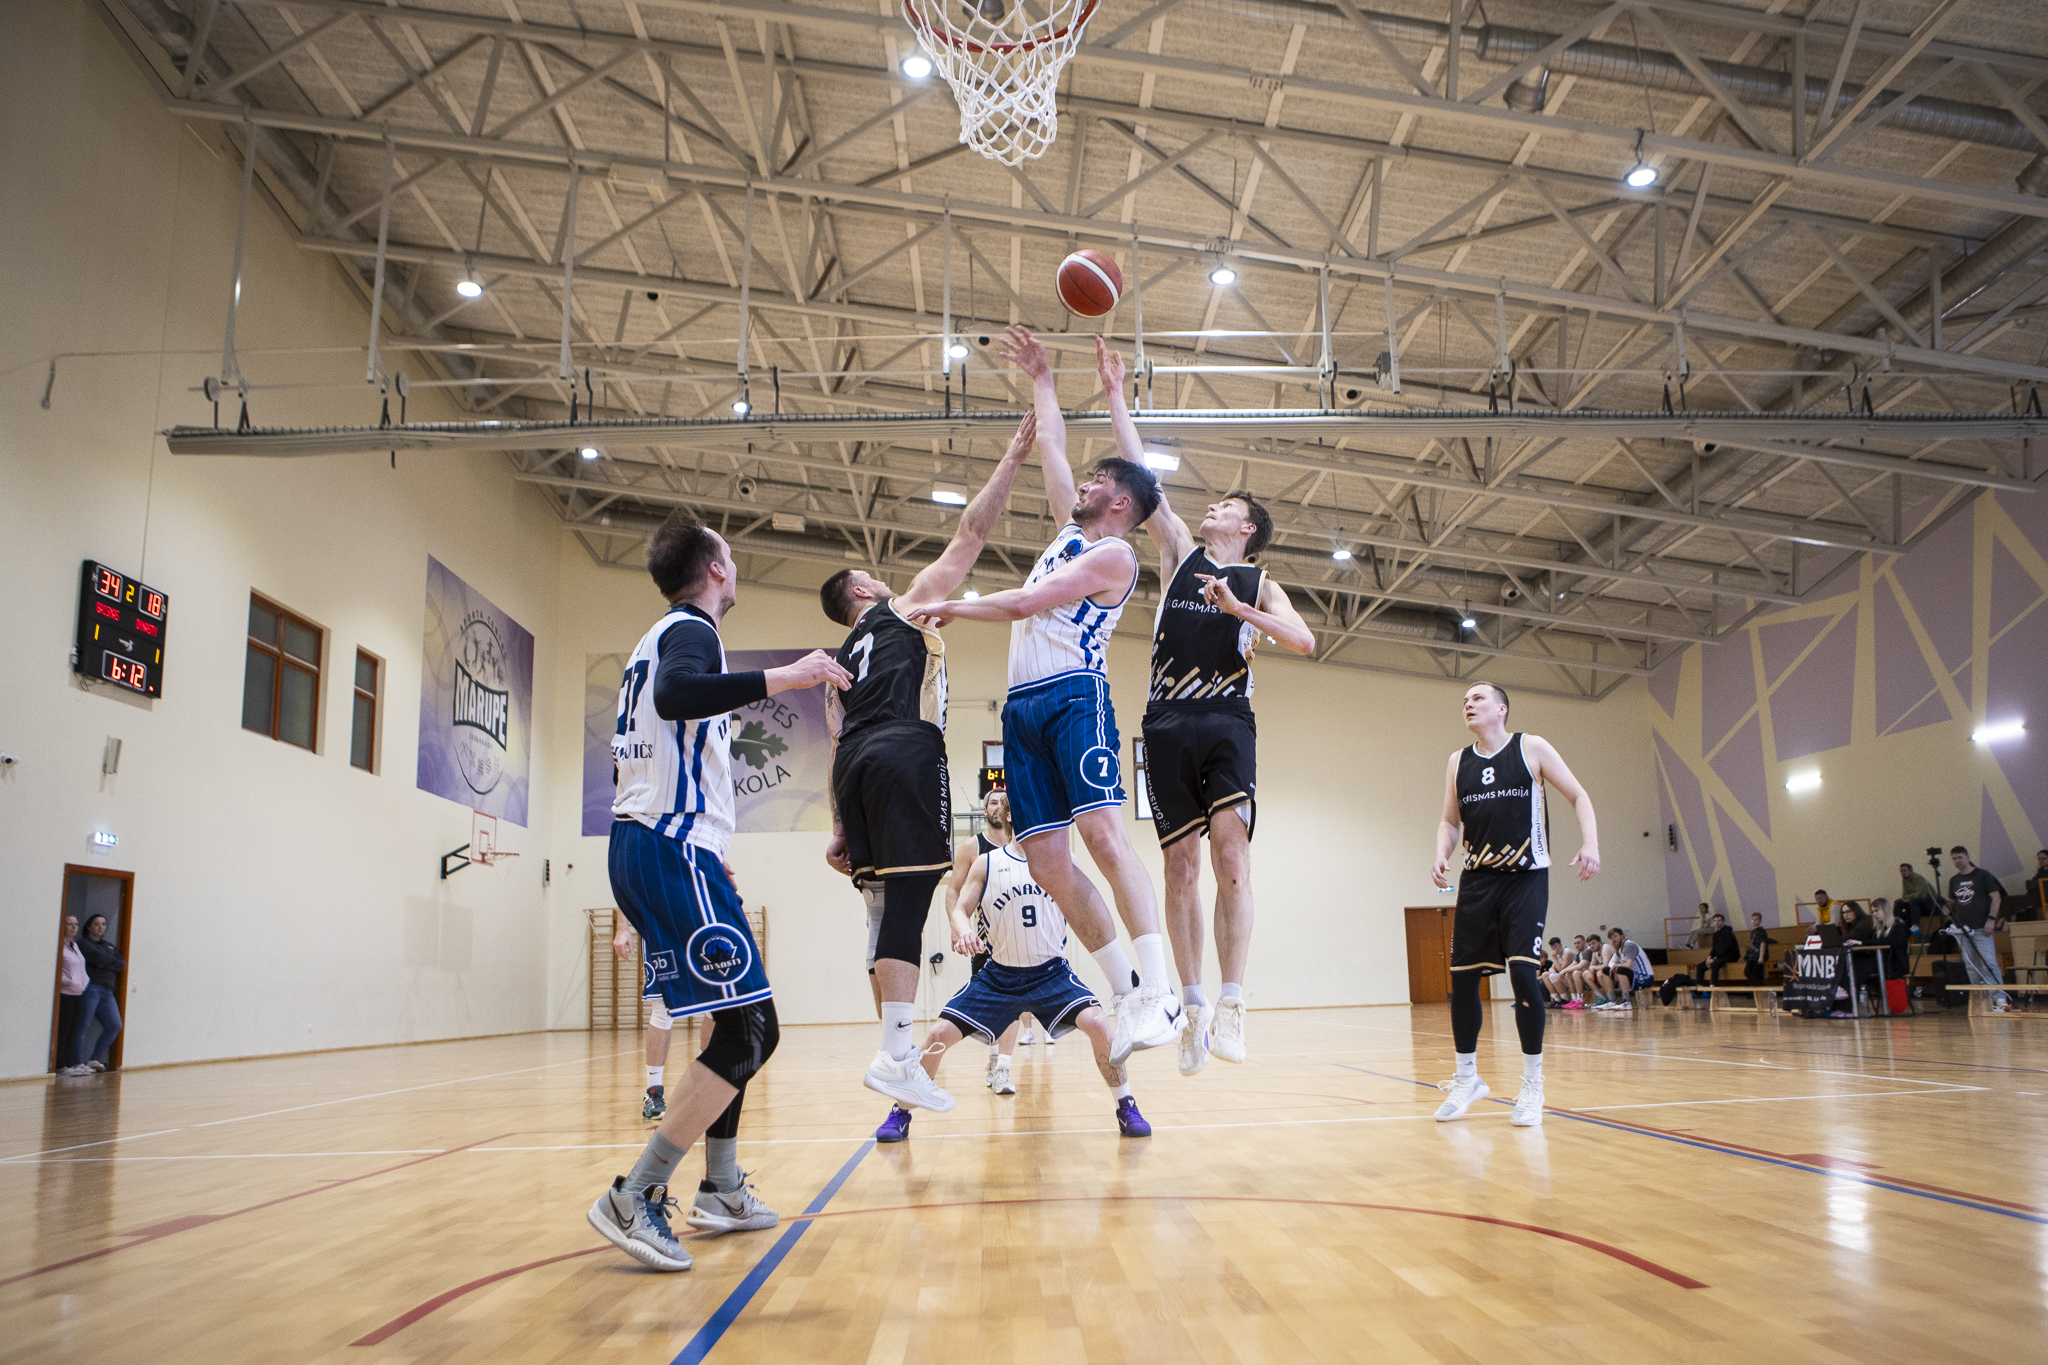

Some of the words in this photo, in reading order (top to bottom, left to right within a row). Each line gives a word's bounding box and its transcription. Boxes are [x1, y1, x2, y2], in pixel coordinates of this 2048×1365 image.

[100, 570, 120, 598] 34
[126, 584, 135, 603] 2
[147, 593, 162, 617] 18
[1171, 598, 1217, 614] GAISMAS
[849, 631, 874, 682] 7
[111, 657, 145, 688] 6:12
[744, 697, 799, 729] UPES
[987, 769, 1005, 781] 6:1
[1098, 756, 1109, 777] 7
[1481, 767, 1495, 785] 8
[734, 764, 791, 796] KOLA
[993, 883, 1054, 910] DYNAS
[1022, 905, 1037, 928] 9
[1532, 936, 1542, 956] 8
[702, 957, 742, 972] DYNASTY
